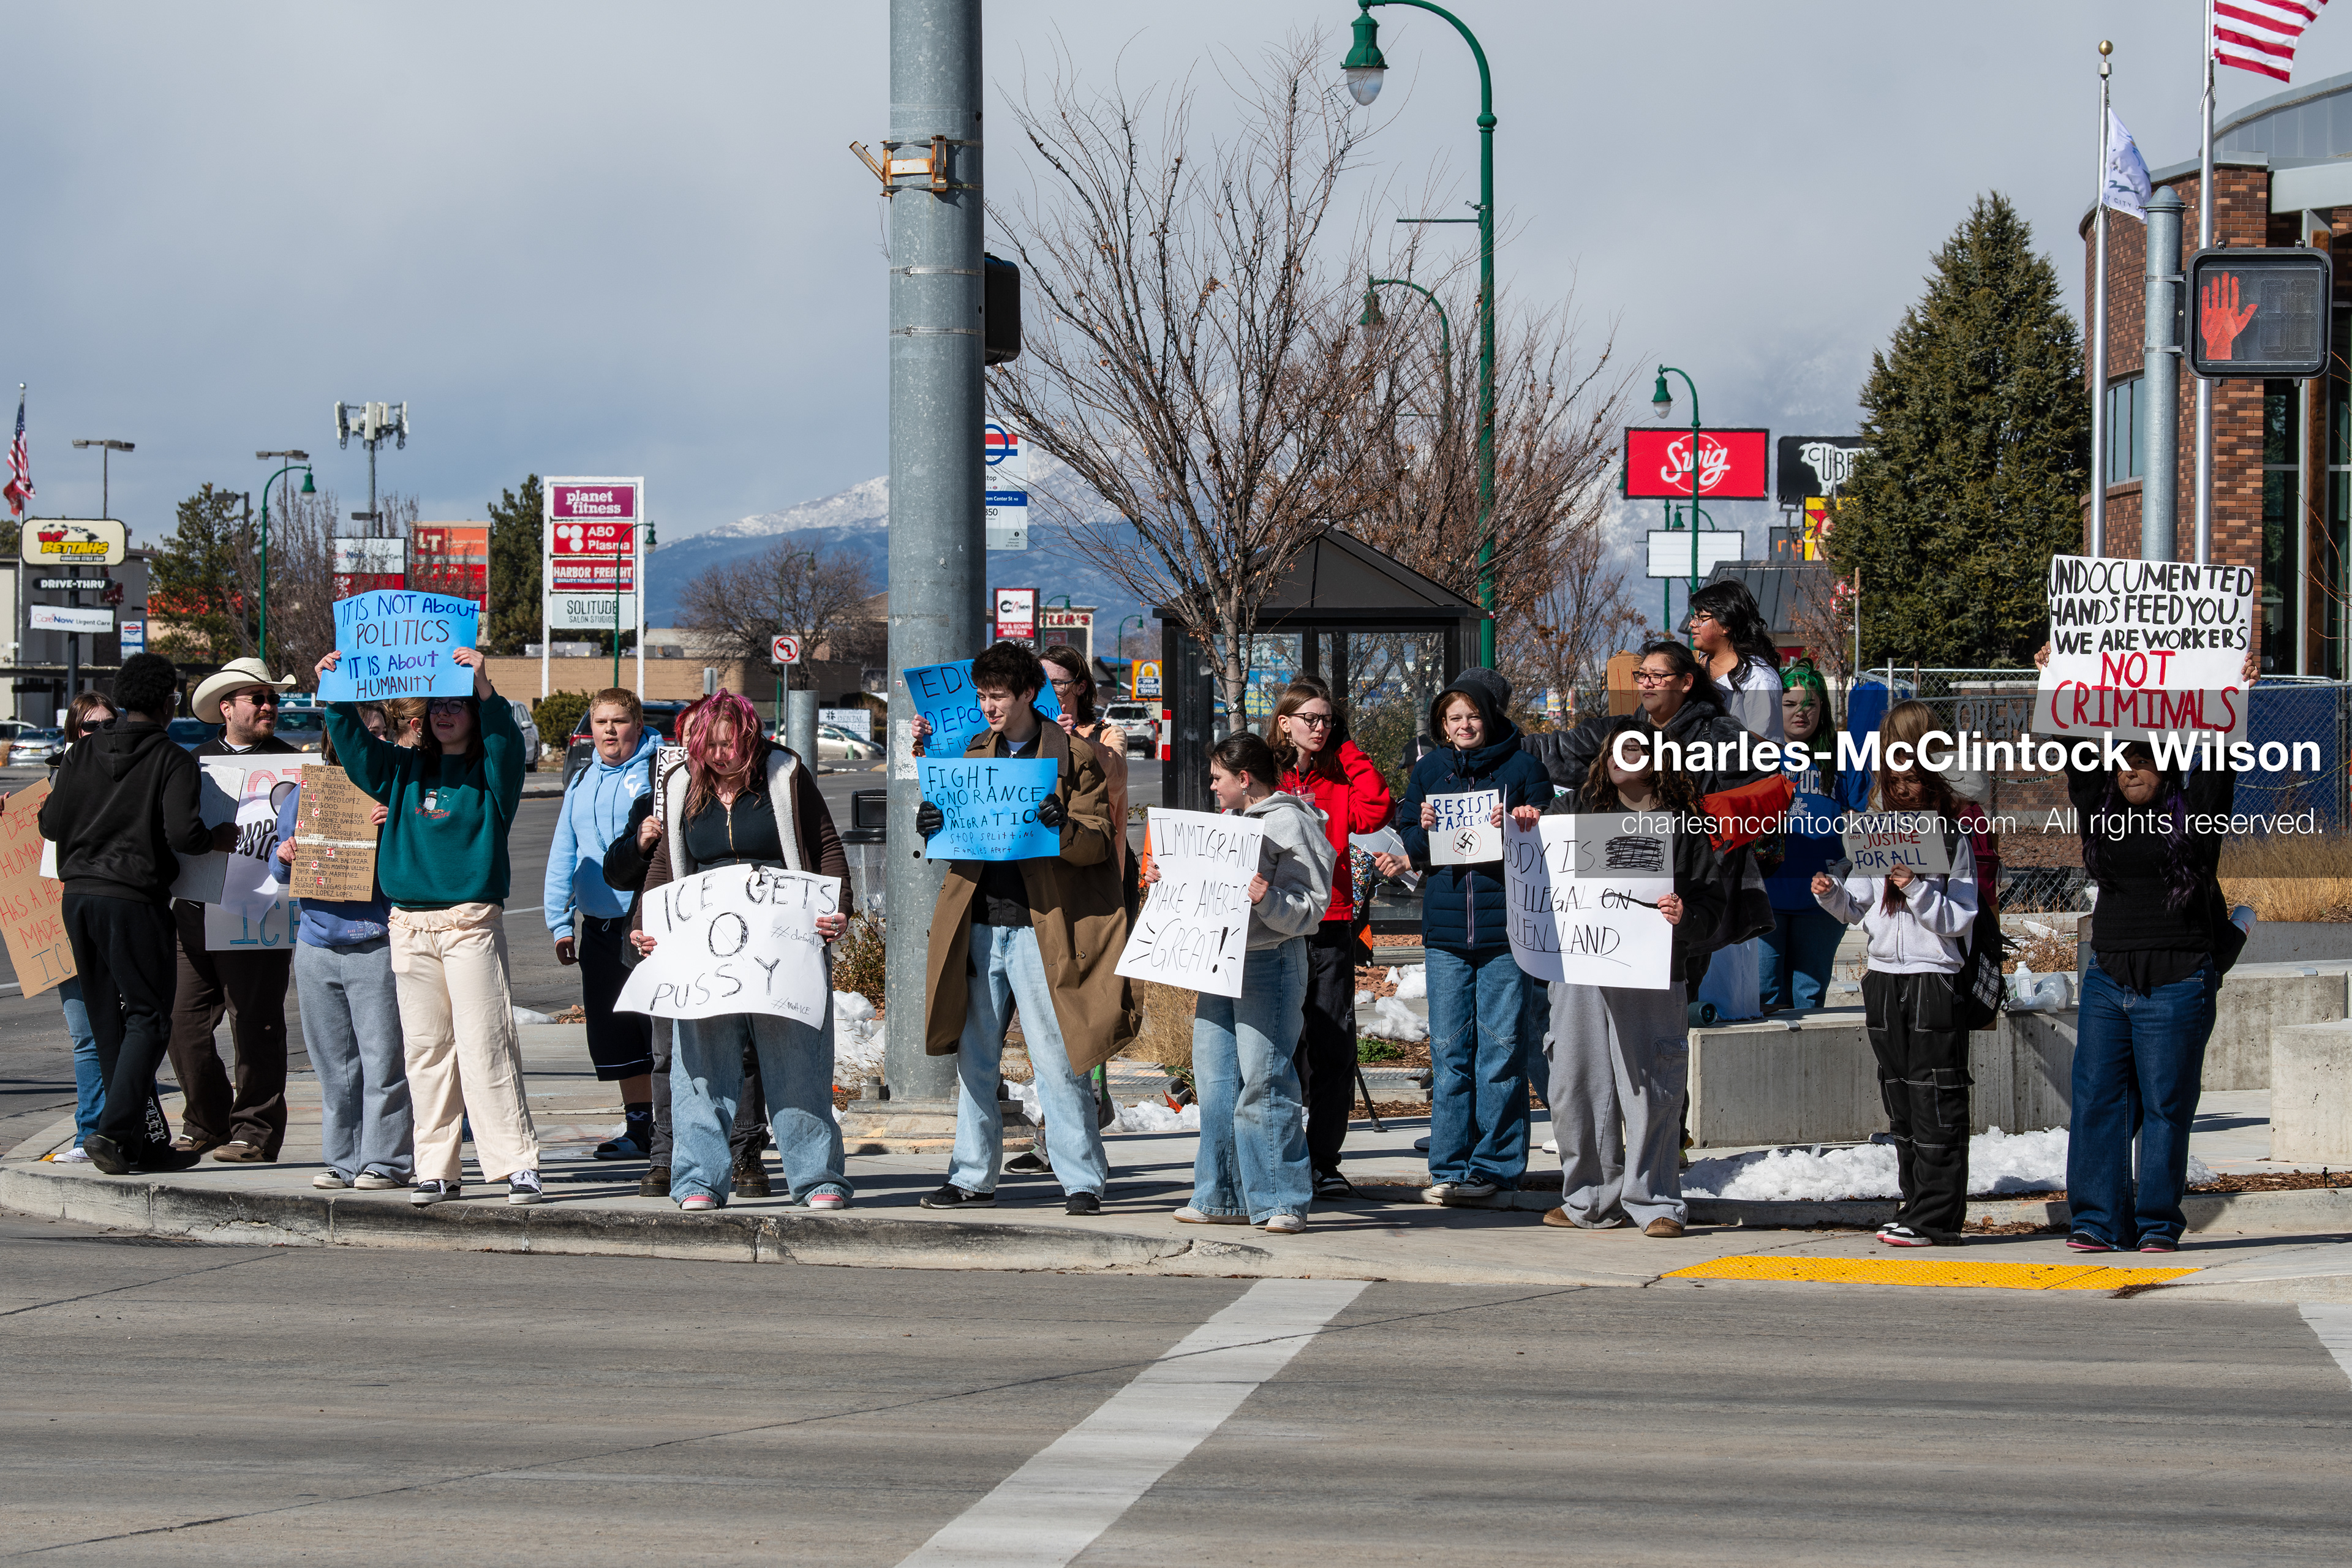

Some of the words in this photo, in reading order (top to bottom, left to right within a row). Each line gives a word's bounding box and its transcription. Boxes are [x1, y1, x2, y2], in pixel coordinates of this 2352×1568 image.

[2114, 197, 2132, 208] CITY
[1660, 440, 1731, 486] Swig
[566, 491, 613, 505] planet
[571, 502, 621, 514] fitness
[37, 530, 68, 542] MO'
[587, 526, 615, 537] ABO
[40, 541, 109, 554] BETTAHS
[40, 579, 105, 589] DRIVE-THRU
[554, 567, 591, 578] HARBOR
[2048, 559, 2255, 597] UNDOCUMENTED
[342, 600, 353, 628] IT
[355, 597, 369, 621] IS
[378, 594, 417, 617] NOT
[422, 597, 480, 620] About
[2049, 596, 2120, 627] HANDS
[2124, 594, 2184, 625] FEED
[356, 619, 450, 649] POLITICS
[2054, 631, 2093, 655] WE
[2098, 629, 2139, 652] ARE
[2142, 626, 2248, 651] WORKERS
[348, 656, 361, 680] IT
[368, 655, 380, 676] IS
[388, 650, 439, 672] About
[2101, 650, 2176, 688] NOT
[1955, 699, 2029, 739] OREM
[2051, 679, 2239, 734] CRIMINALS
[301, 780, 318, 788] FELIX
[624, 774, 643, 798] CV
[929, 766, 999, 791] FIGHT
[925, 785, 1046, 806] IGNORANCE
[1434, 793, 1494, 815] RESIST
[1151, 817, 1261, 872] IMMIGRANTS
[1863, 829, 1921, 850] JUSTICE
[1557, 840, 1596, 872] IS
[1855, 850, 1889, 870] FOR
[1890, 848, 1928, 866] ALL
[29, 888, 42, 910] A
[664, 872, 716, 933] ICE
[745, 873, 834, 915] GETS
[1145, 880, 1188, 913] MAKE
[1510, 875, 1592, 913] ILLEGAL
[18, 914, 63, 950] MADE
[1557, 921, 1621, 956] LAND
[649, 956, 782, 1011] PUSSY
